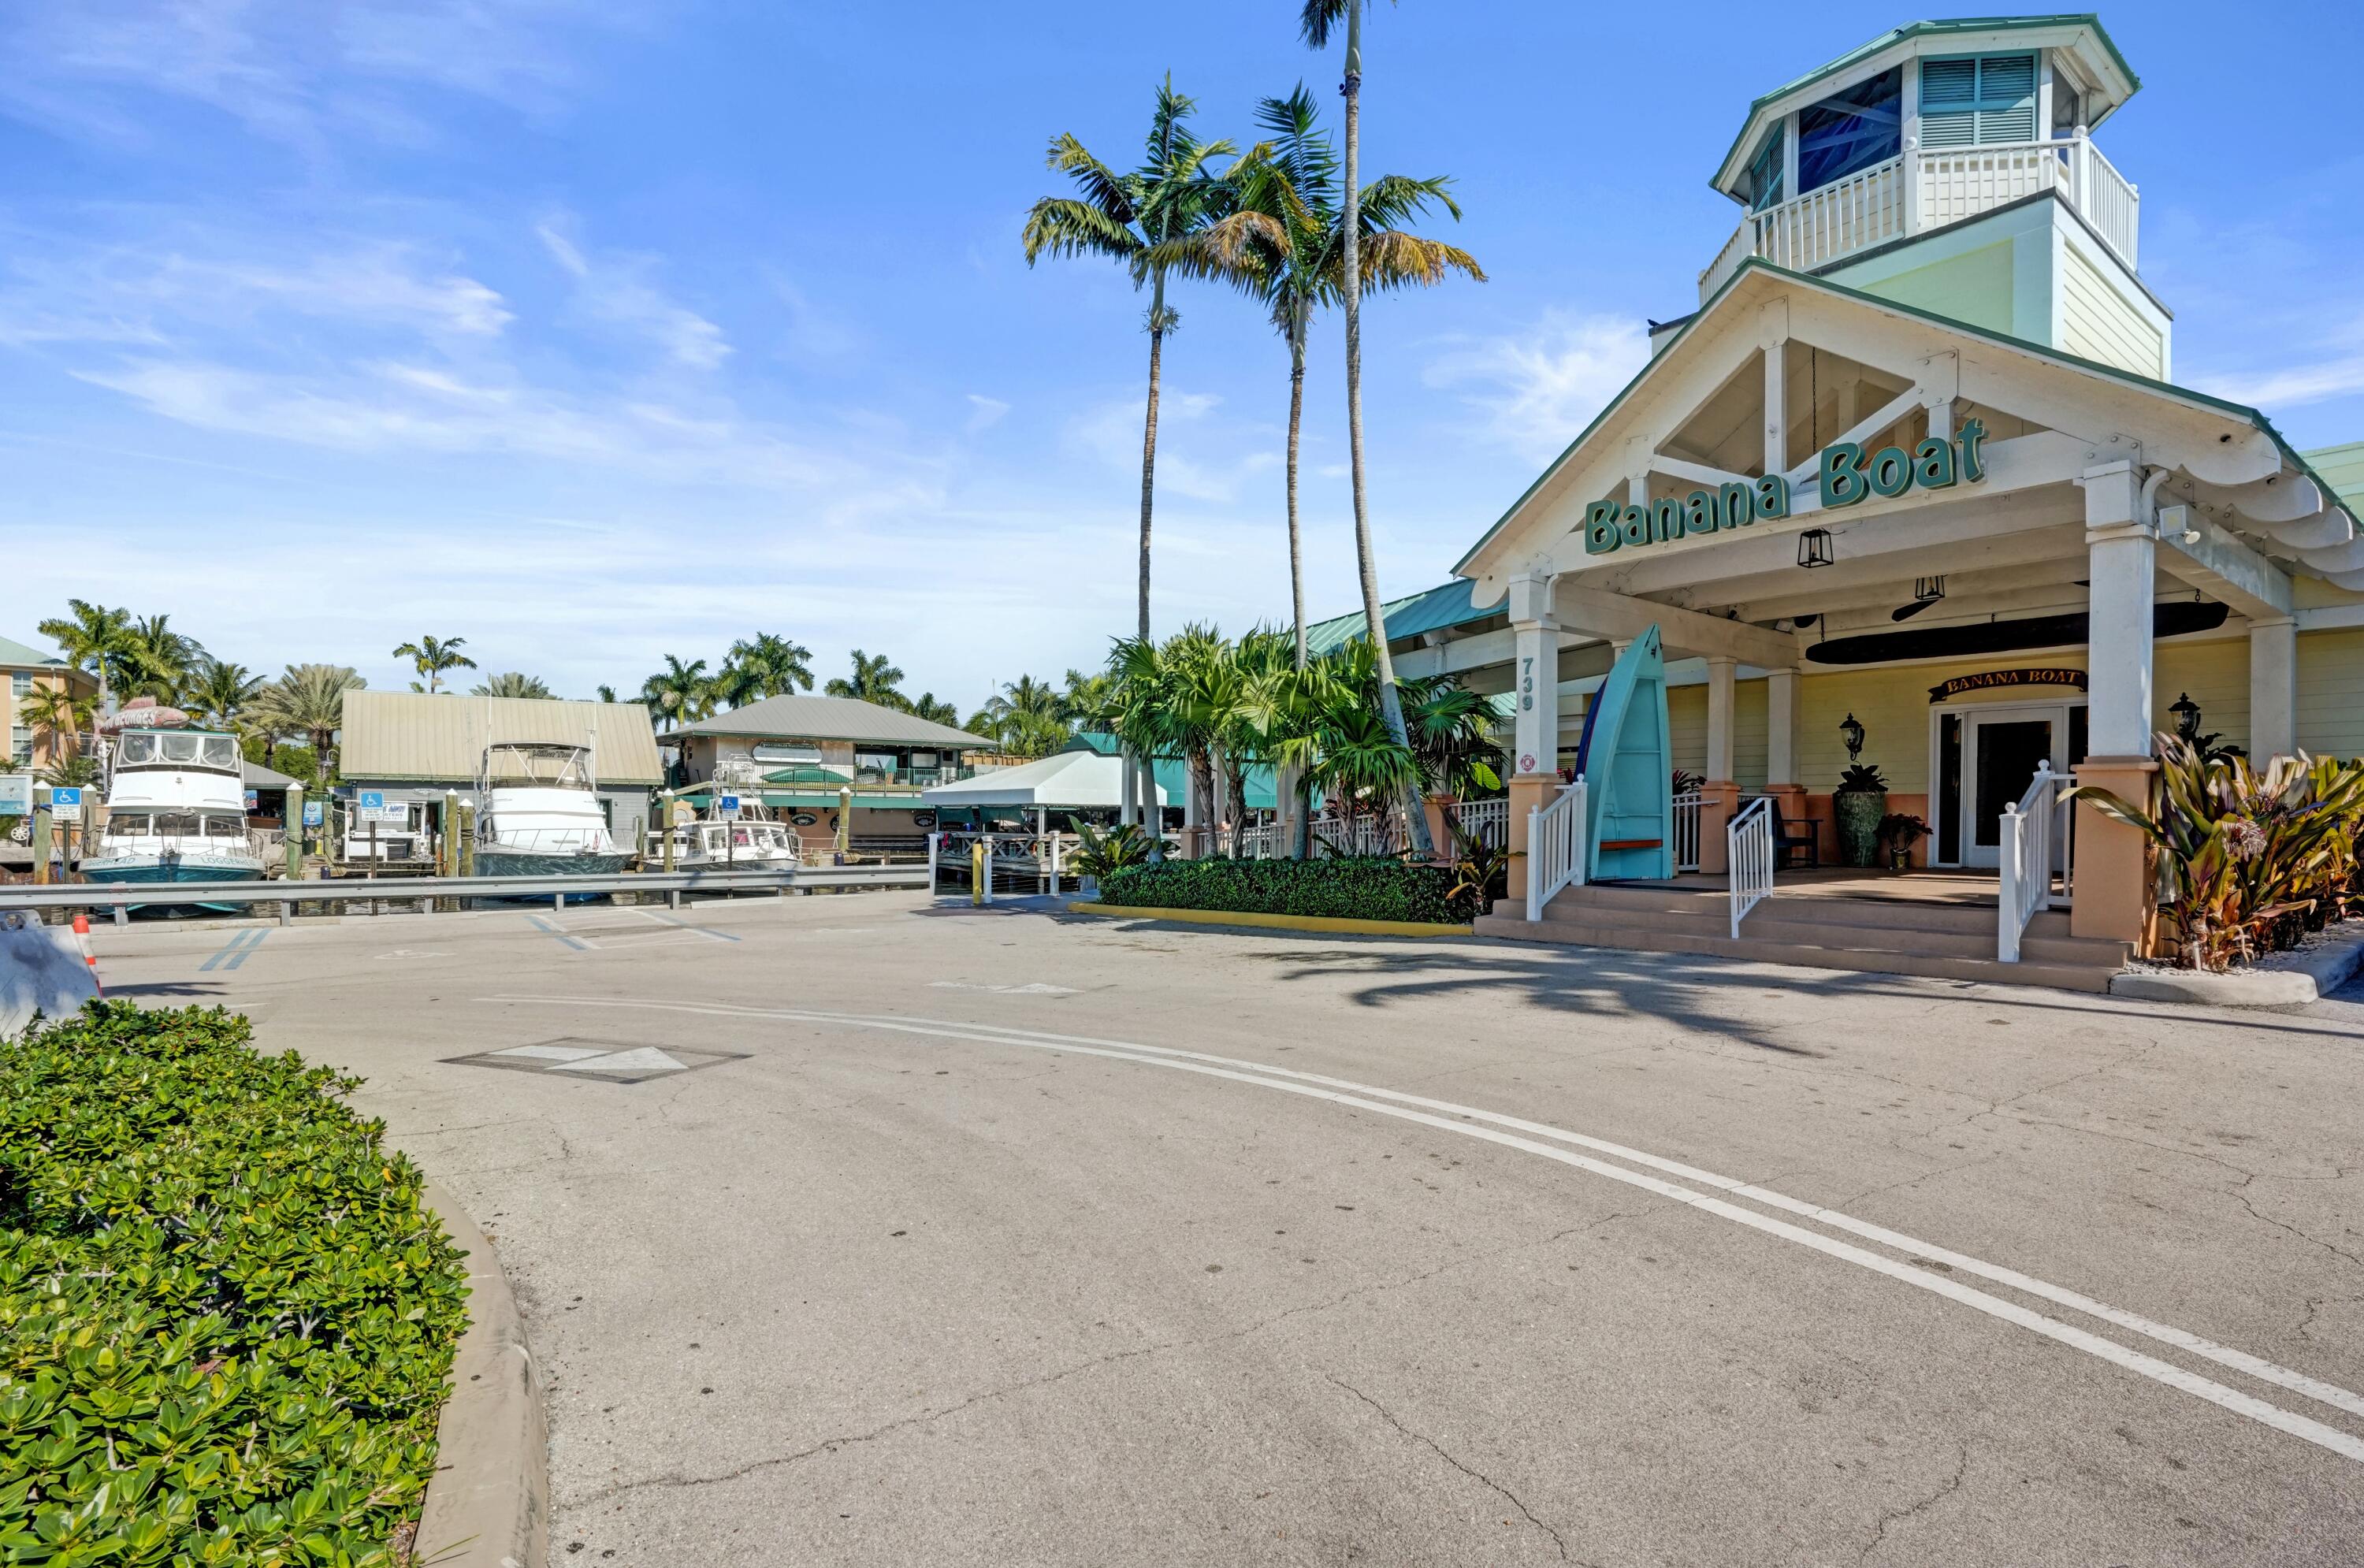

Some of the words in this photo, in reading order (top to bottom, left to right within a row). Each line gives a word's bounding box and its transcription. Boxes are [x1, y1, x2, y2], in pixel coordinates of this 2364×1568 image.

[1585, 474, 1790, 555] Banana
[1819, 417, 1990, 510] Boat
[1522, 657, 1533, 711] 739
[1946, 671, 2019, 693] BANANA
[2028, 670, 2081, 683] BOAT
[532, 749, 556, 758] Miller
